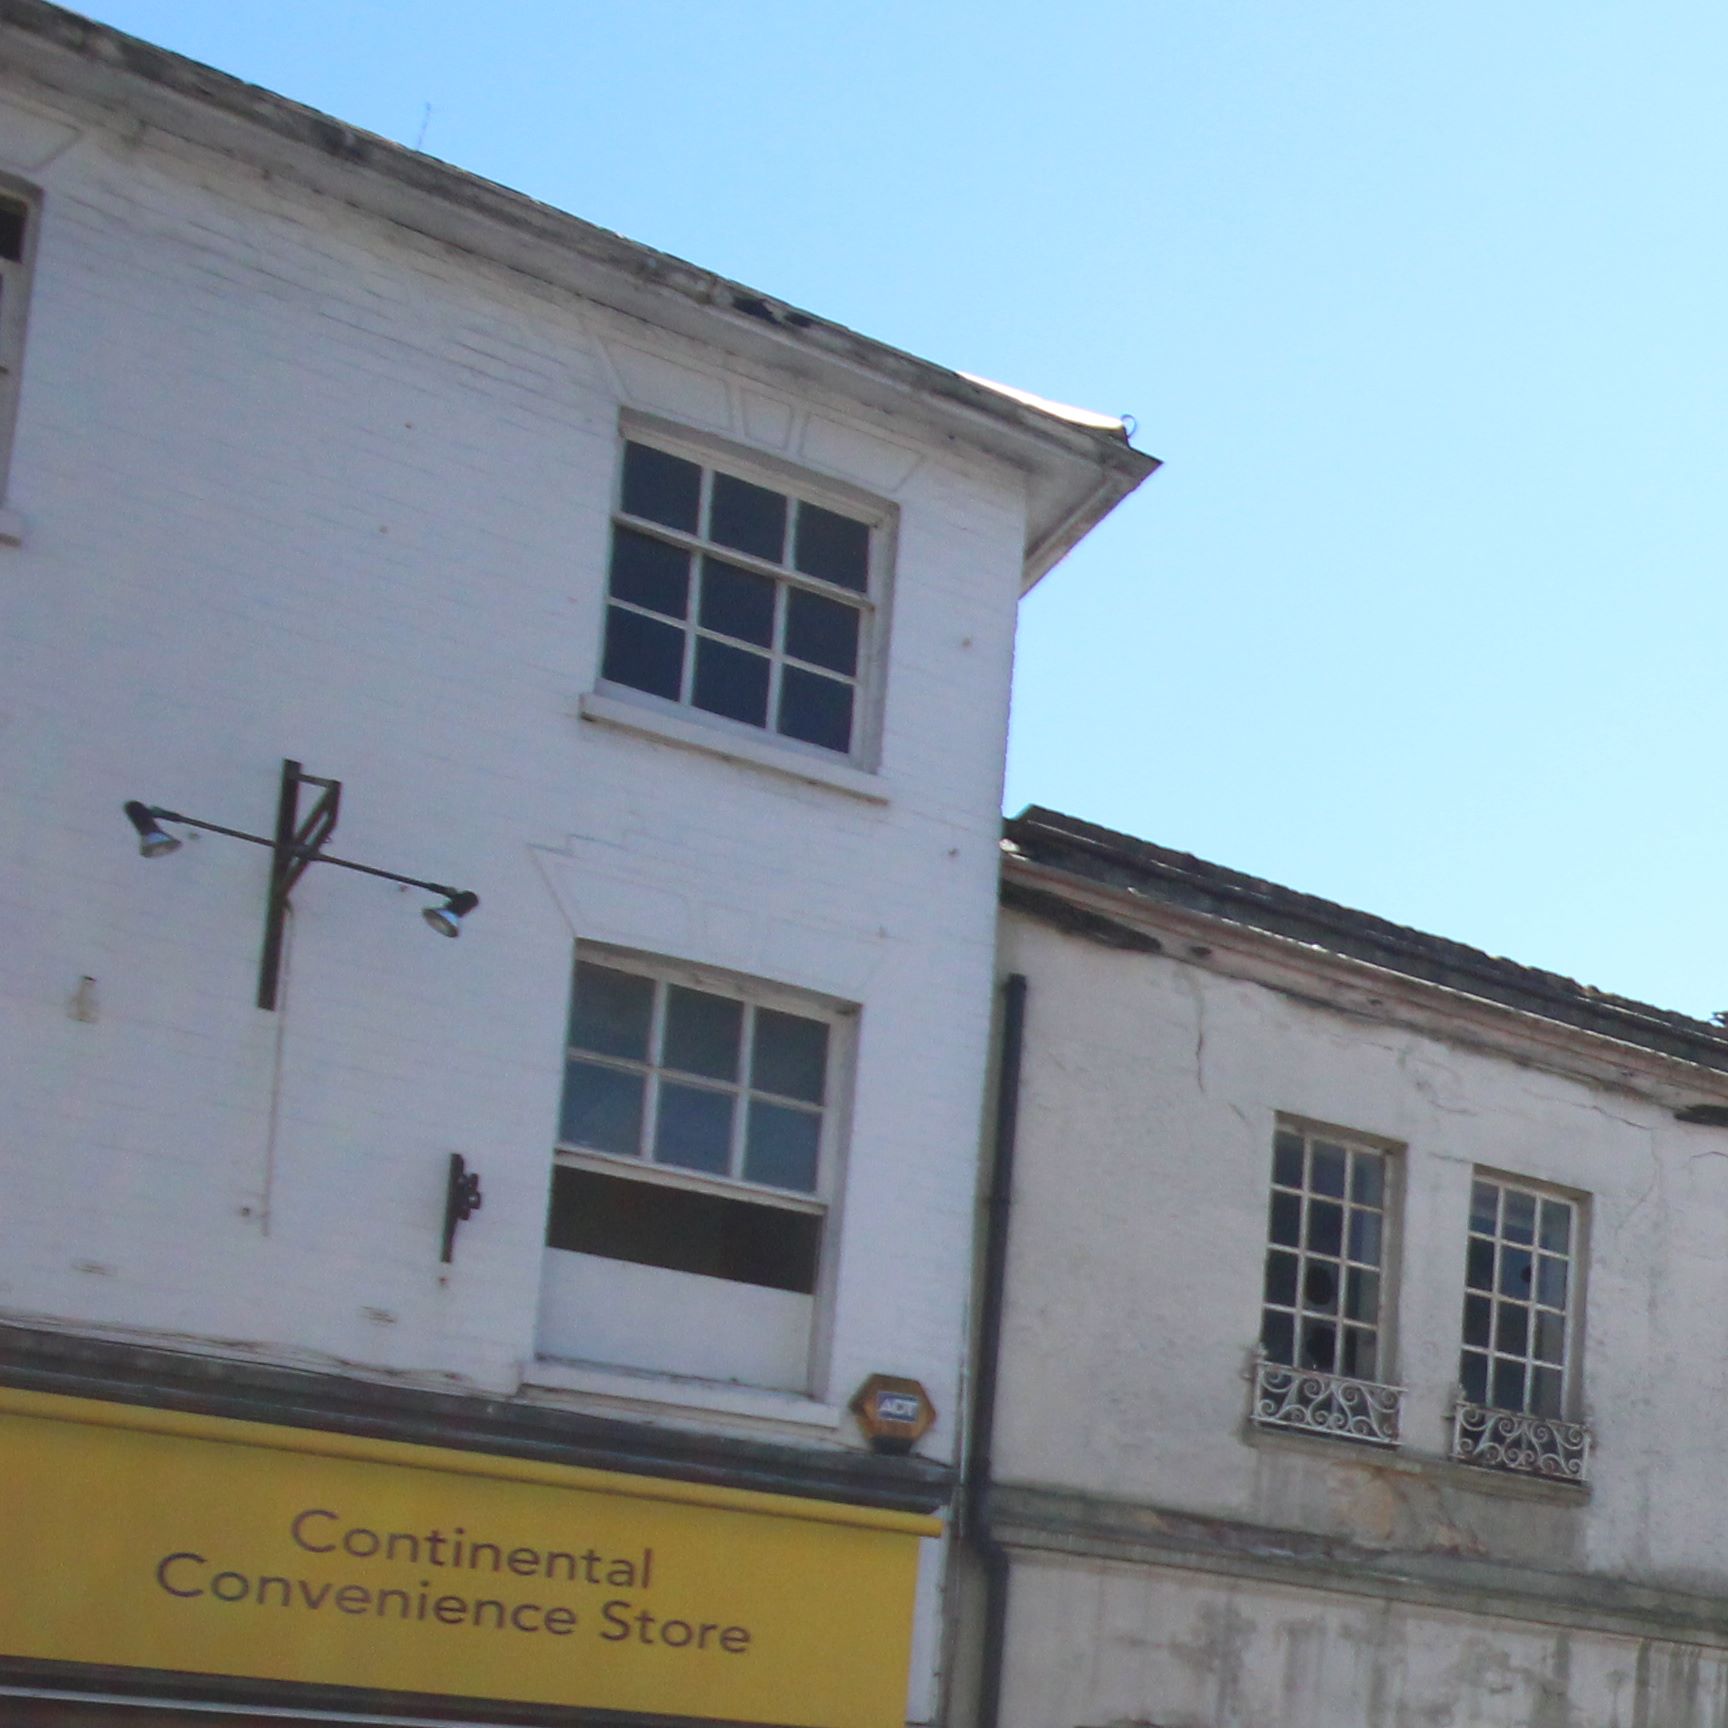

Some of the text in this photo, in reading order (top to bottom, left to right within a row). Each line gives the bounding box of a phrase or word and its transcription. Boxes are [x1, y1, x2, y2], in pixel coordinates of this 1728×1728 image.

[291, 1508, 655, 1589] Continental
[156, 1552, 751, 1654] Convenience Store
